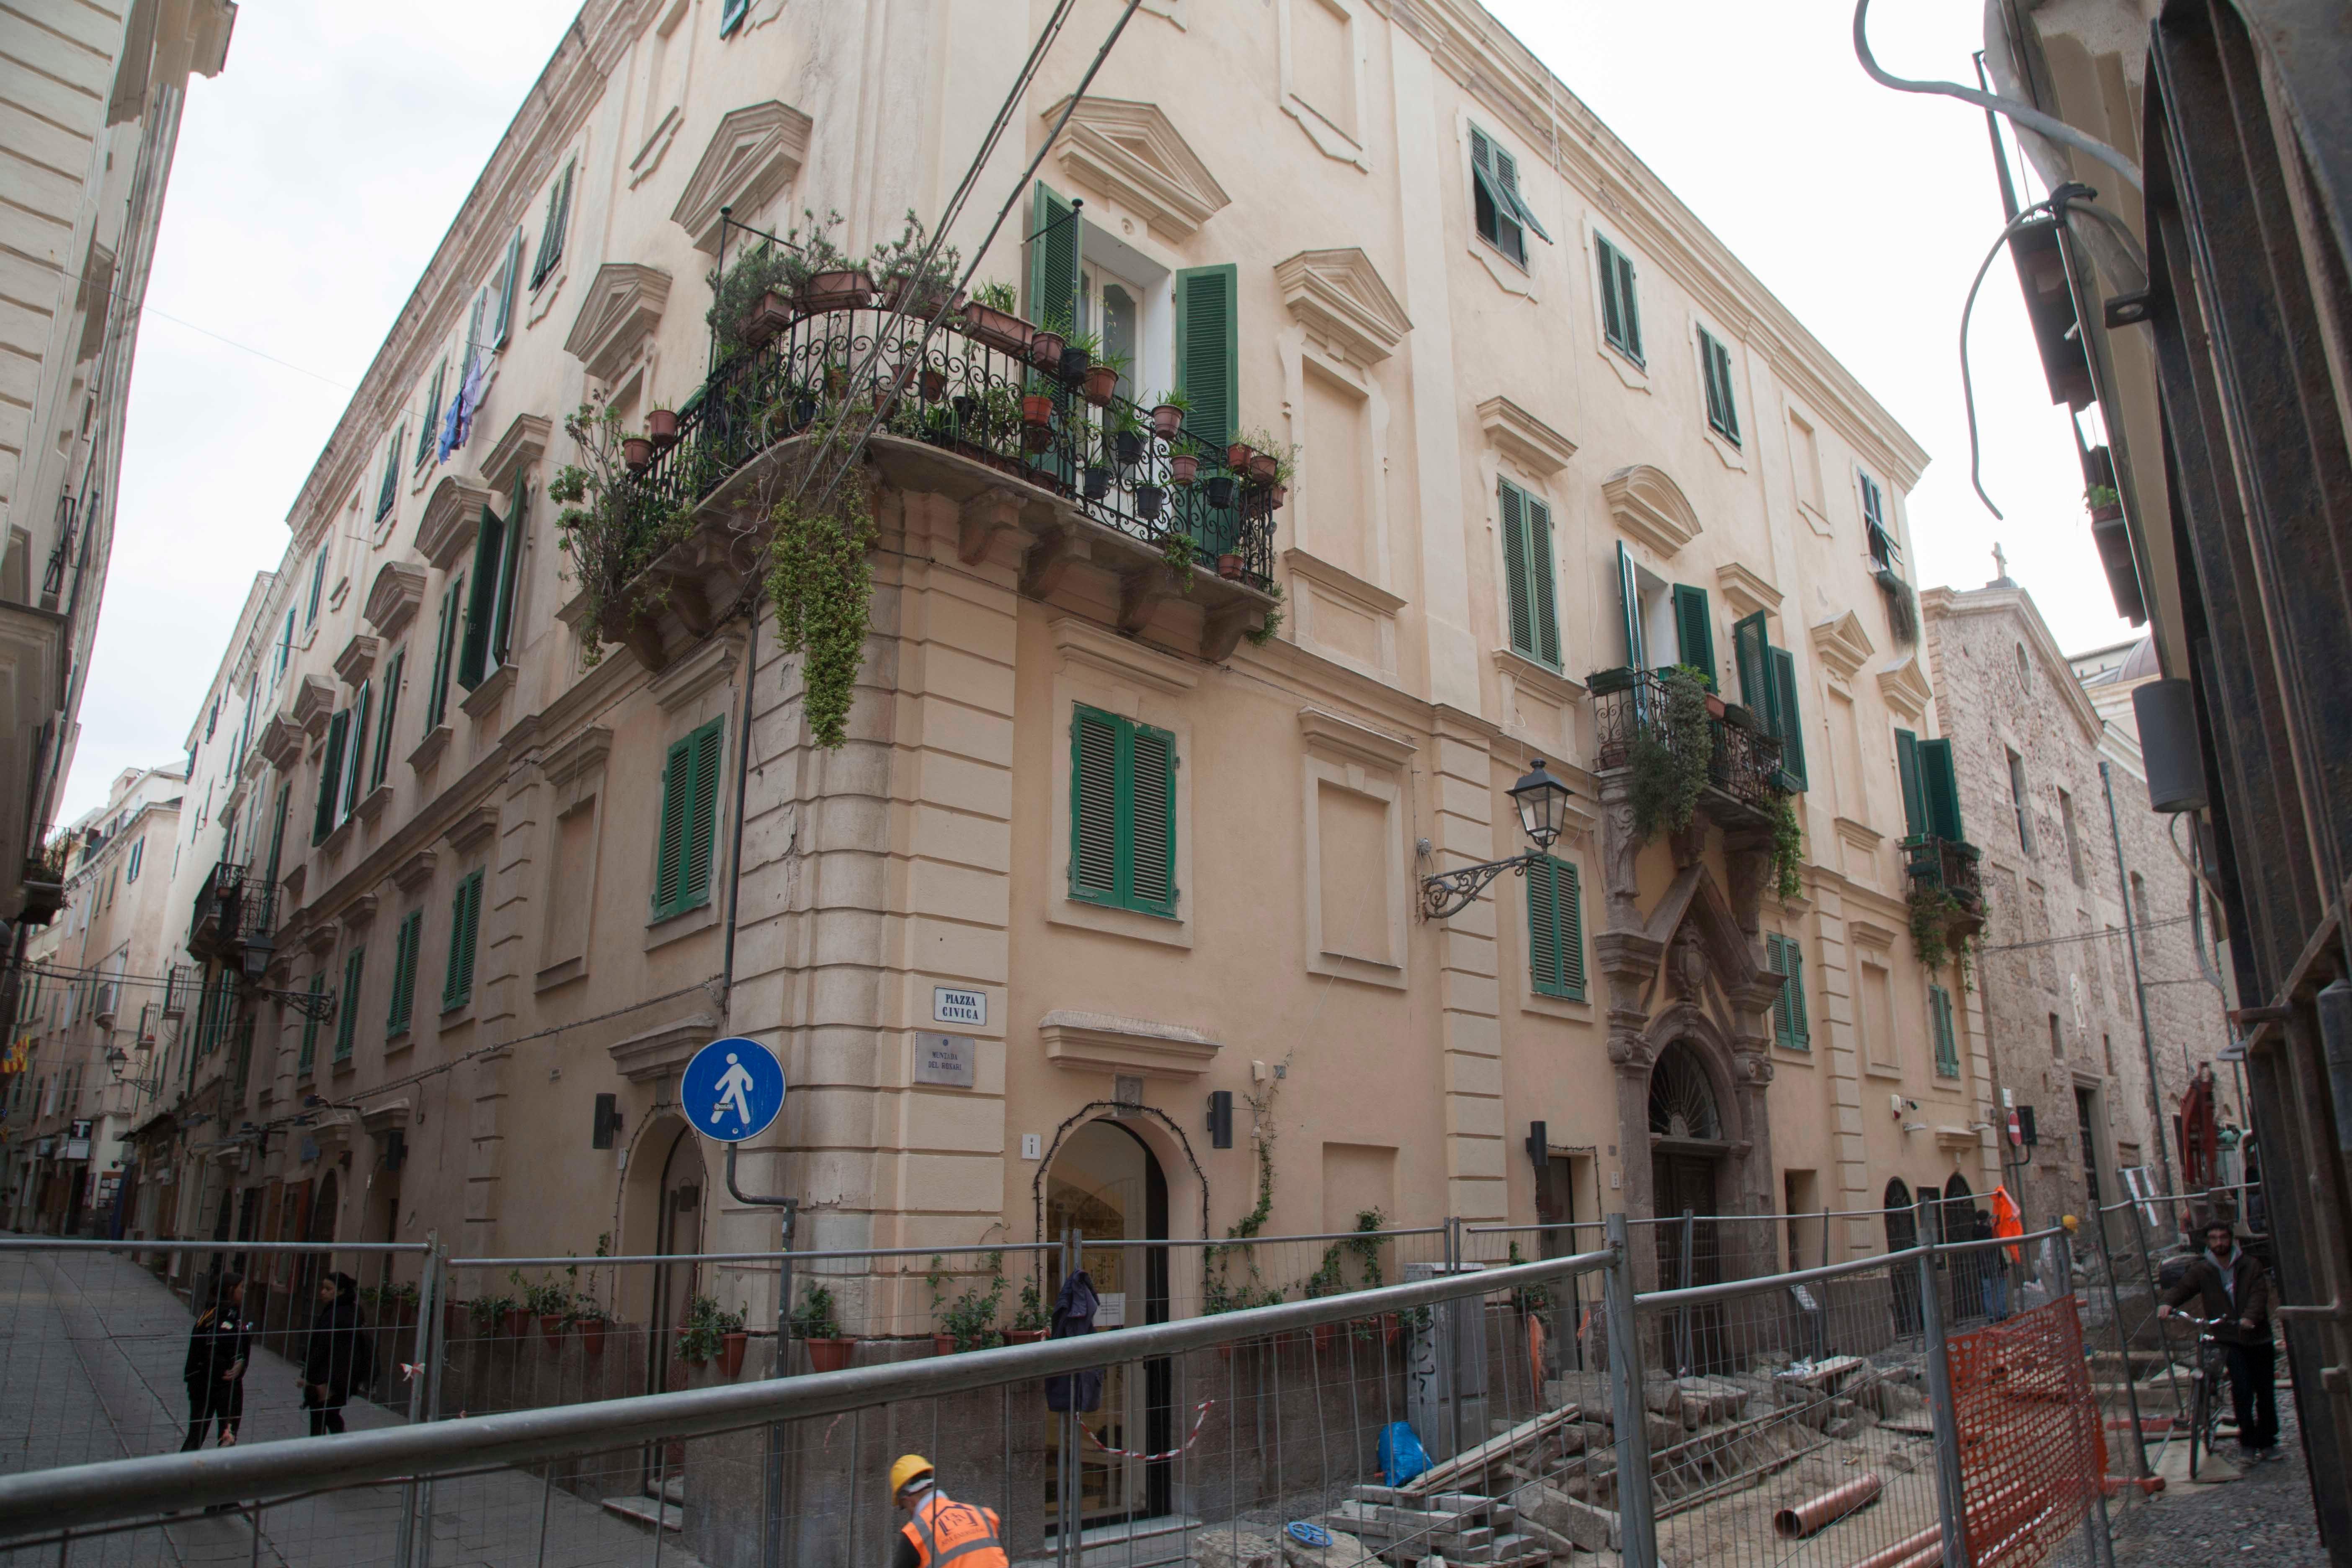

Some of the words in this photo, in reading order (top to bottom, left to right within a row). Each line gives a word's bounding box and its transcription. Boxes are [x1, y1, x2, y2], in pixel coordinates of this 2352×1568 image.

[945, 994, 976, 1006] PIAZZA
[943, 1006, 978, 1019] CIVICA
[932, 1051, 958, 1060] MUNTADA
[73, 1121, 91, 1137] T
